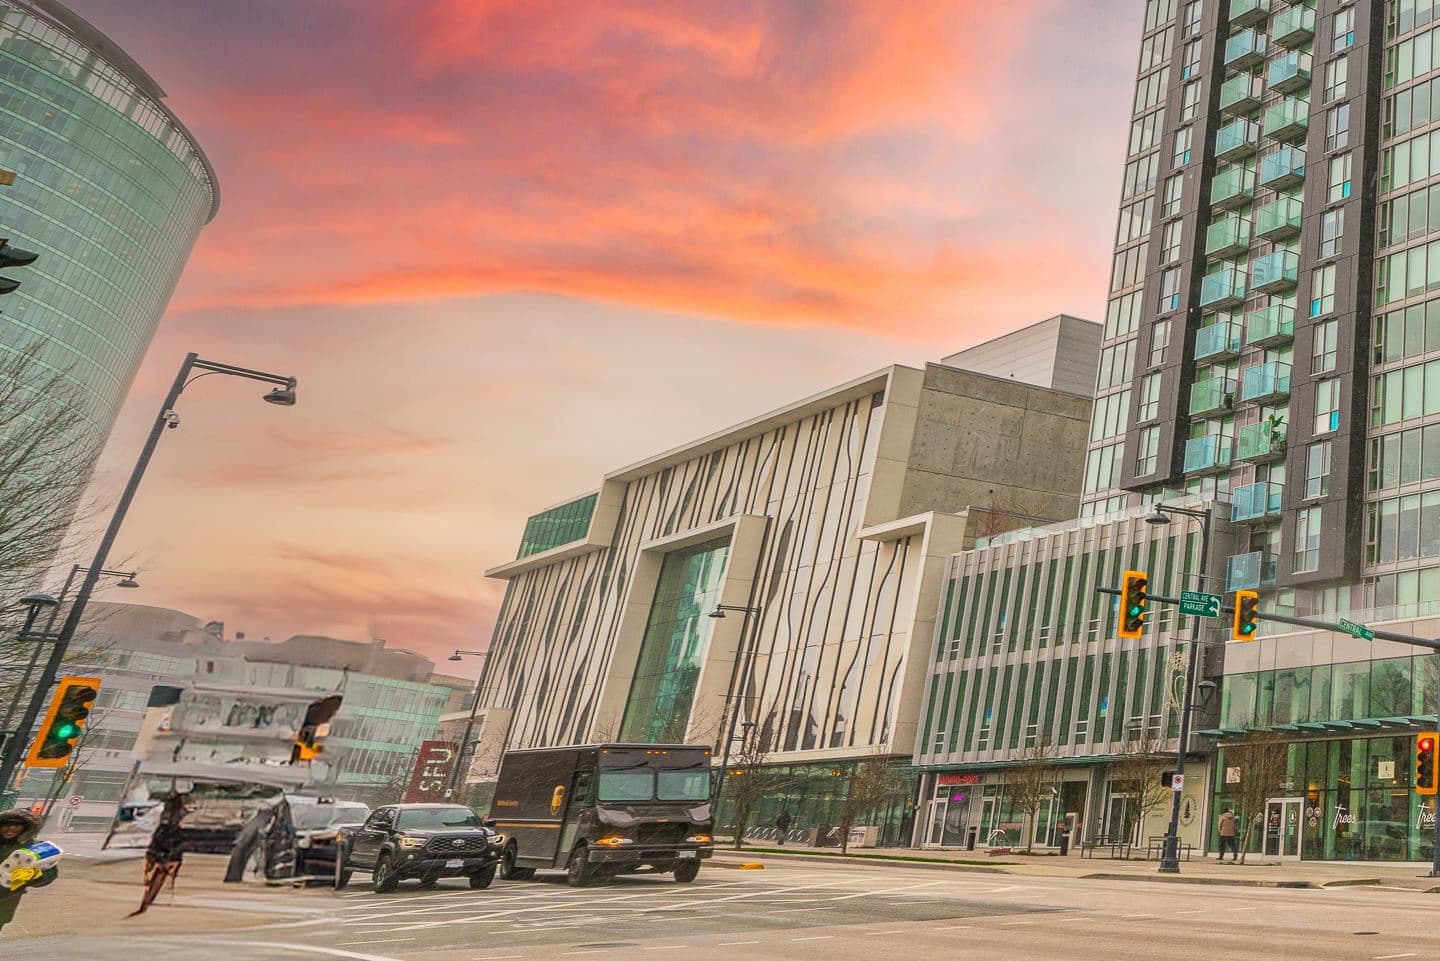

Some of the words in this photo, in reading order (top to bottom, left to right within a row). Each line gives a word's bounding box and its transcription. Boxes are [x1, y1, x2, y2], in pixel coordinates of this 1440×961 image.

[1182, 592, 1200, 601] CENTRAL
[1183, 602, 1206, 612] PARKADE
[419, 748, 452, 792] SFU
[1333, 803, 1357, 830] Trees
[1416, 802, 1436, 830] Tree
